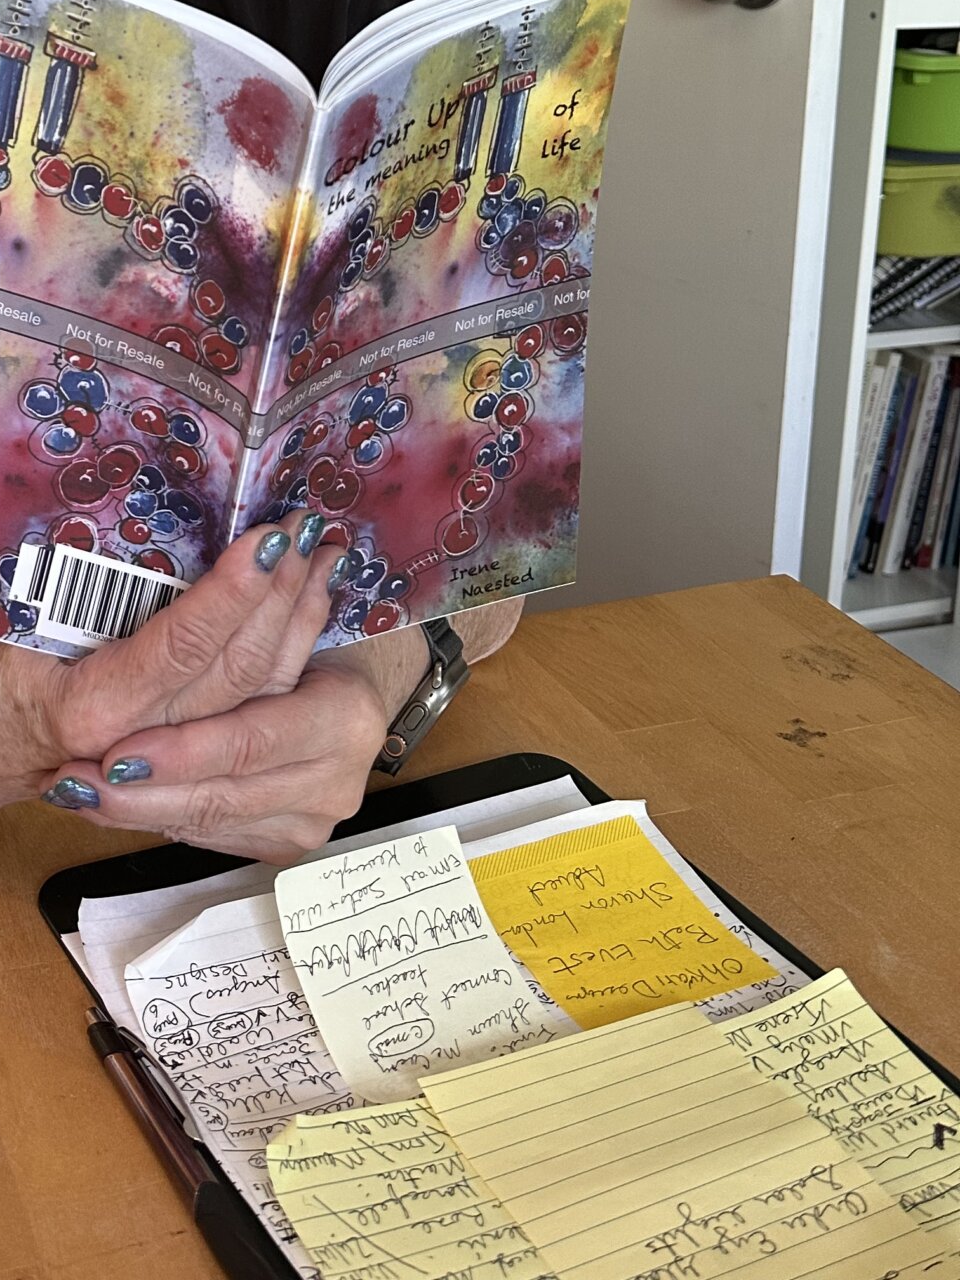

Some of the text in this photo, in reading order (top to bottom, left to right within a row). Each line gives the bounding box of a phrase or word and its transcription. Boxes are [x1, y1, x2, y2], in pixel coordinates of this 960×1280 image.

[553, 88, 582, 120] of
[323, 96, 463, 188] Colour Up
[540, 129, 582, 160] life
[327, 138, 451, 216] the meaning
[553, 288, 590, 307] Not for
[454, 302, 535, 333] Not for Resale
[66, 323, 166, 370] Not for Resale
[358, 329, 436, 367] Not for Resale
[188, 371, 212, 396] Not
[213, 387, 230, 407] for
[276, 368, 343, 420] Not for Resale
[449, 560, 501, 582] Irene
[462, 566, 535, 599] Naested
[413, 835, 428, 858] to
[581, 881, 672, 912] Sharon
[496, 909, 578, 948] London
[638, 922, 718, 952] Beth
[164, 962, 247, 991] Designs
[360, 963, 427, 996] teacher
[440, 968, 512, 1010] Connect
[565, 979, 654, 1007] Designs
[361, 991, 429, 1030] School
[466, 997, 530, 1036] Shawn
[754, 999, 821, 1033] Irene
[765, 1024, 841, 1055] Mary
[770, 1038, 864, 1083] Angela
[780, 1191, 868, 1231] Order
[711, 1226, 778, 1255] Eye
